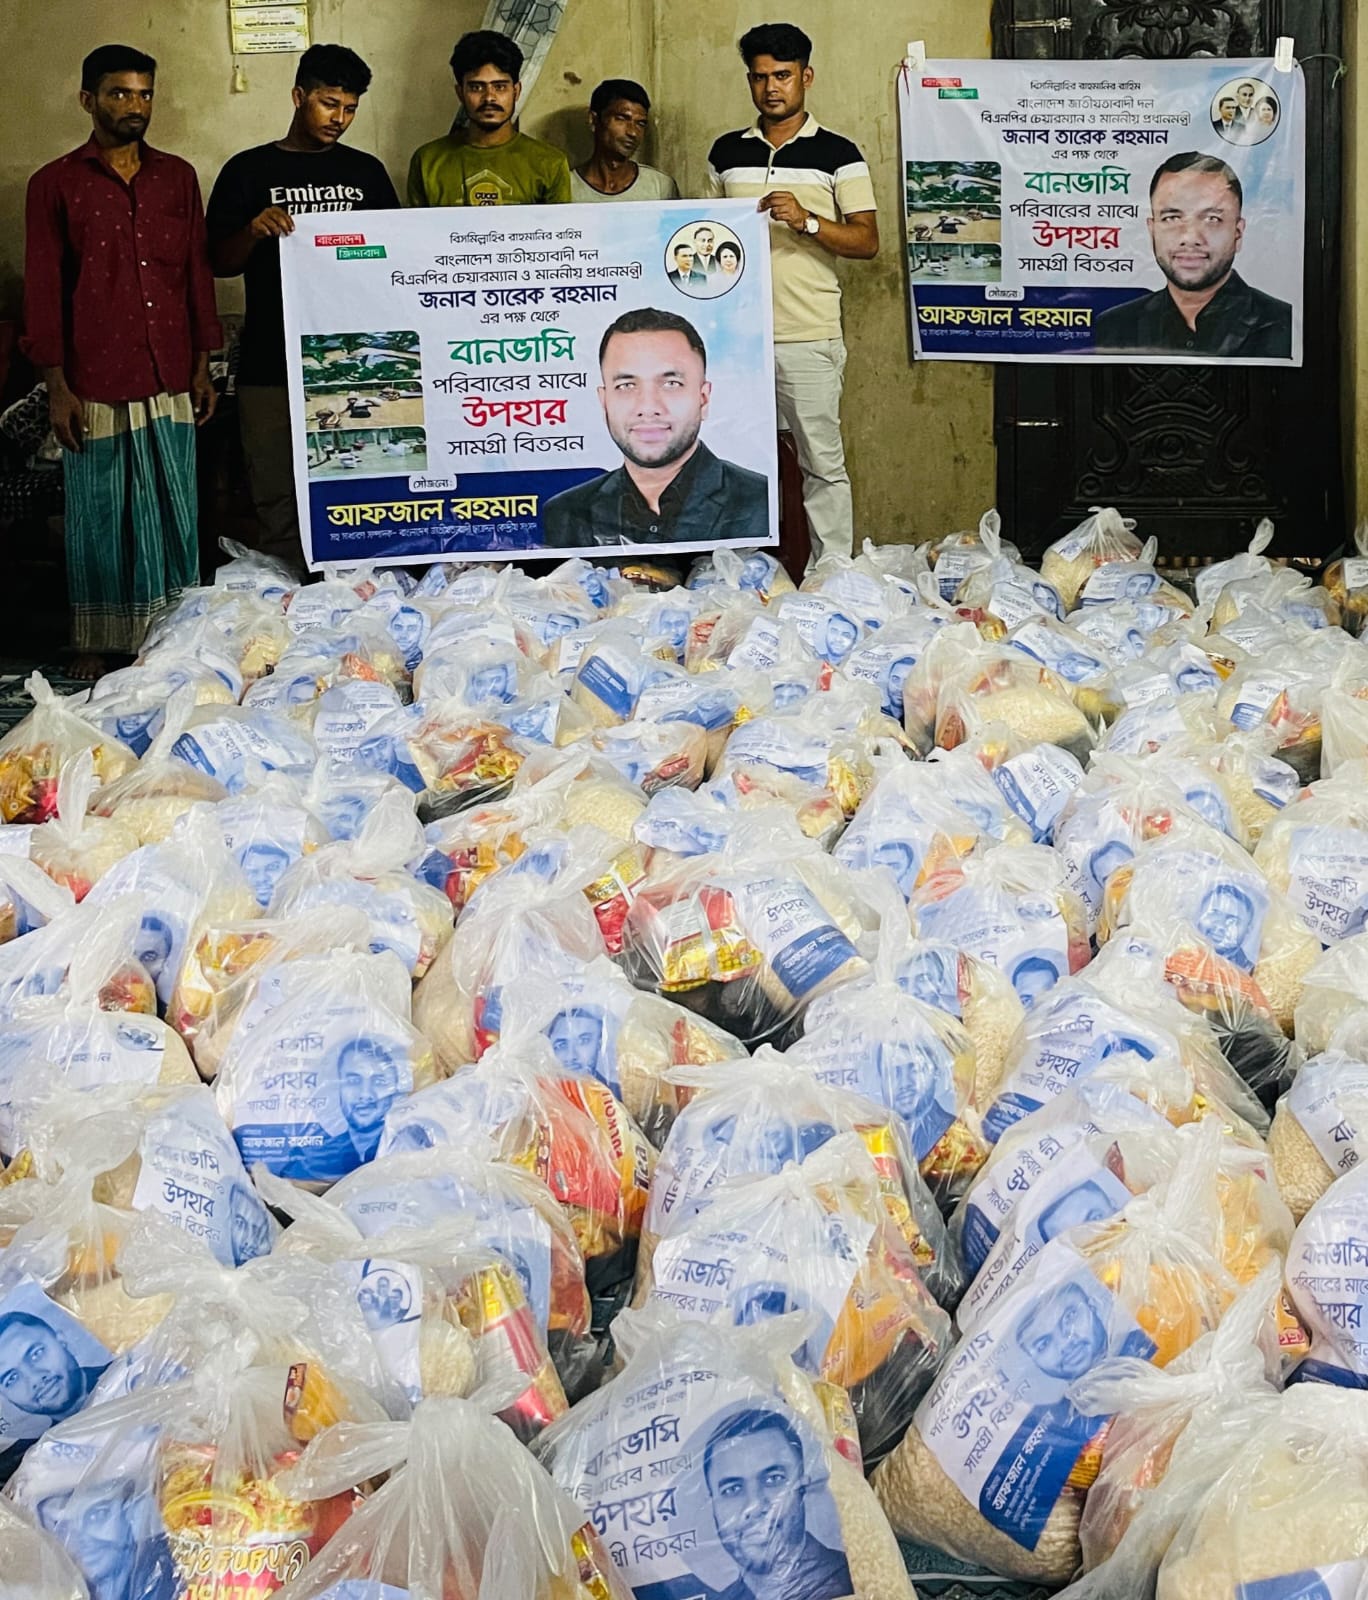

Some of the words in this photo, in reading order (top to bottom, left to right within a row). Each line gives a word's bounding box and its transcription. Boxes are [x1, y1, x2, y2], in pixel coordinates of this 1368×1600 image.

[1017, 98, 1064, 109] বাংলাদেশ
[1068, 95, 1134, 109] জাতীয়তাবাদী
[1137, 98, 1154, 109] দল
[981, 110, 1027, 123] বিএনপির
[1030, 112, 1085, 124] চেয়ারম্যান
[1088, 115, 1096, 123] ও
[1100, 110, 1140, 124] মাননীয়
[1143, 110, 1191, 127] প্রধানমন্ত্রী
[1002, 130, 1050, 145] জনাব
[1055, 130, 1106, 145] তারেক
[1112, 130, 1169, 146] রহমান
[1051, 150, 1067, 160] এর
[1072, 150, 1090, 160] পক্ষ
[1093, 150, 1119, 160] থেকে
[1024, 166, 1132, 195] বানভাসি
[270, 184, 364, 204] Emirates
[1009, 199, 1091, 218] পরিবারের
[1097, 204, 1138, 219] মাঝে
[317, 234, 362, 245] বাংলাদেশ
[450, 231, 505, 246] বিসমিল্লাহির
[508, 229, 553, 242] রাহমানির
[555, 228, 582, 240] রাহিম
[1032, 220, 1121, 249] উপহার
[434, 253, 492, 267] বাংলাদেশ
[496, 246, 575, 264] জাতীয়তাবাদী
[578, 249, 599, 262] দল
[1019, 253, 1067, 272] সামগ্রী
[1074, 254, 1134, 272] বিতরন
[391, 270, 448, 287] বিএনপির
[452, 270, 518, 285] চেয়ারম্যান
[521, 272, 531, 281] ও
[535, 264, 583, 280] মাননীয়
[586, 262, 643, 280] প্রধানমন্ত্রী
[418, 290, 476, 310] জনাব
[482, 287, 545, 307] তারেক
[551, 284, 618, 304] রহমান
[480, 313, 500, 325] এর
[504, 311, 526, 324] পক্ষ
[530, 309, 560, 322] থেকে
[918, 306, 1013, 326] আফজাল
[1019, 309, 1092, 328] রহমান
[448, 328, 576, 366] বানভাসি
[432, 372, 531, 394] পরিবারের
[537, 373, 588, 389] মাঝে
[462, 396, 568, 427] উপহার
[447, 433, 506, 456] সামগ্রী
[513, 432, 584, 453] বিতরন
[326, 499, 445, 526] আফজাল
[450, 495, 538, 521] রহমান
[1304, 891, 1352, 924] উপহার
[1035, 1050, 1083, 1078] উপহার
[815, 1069, 859, 1086] পহার
[633, 1145, 649, 1191] Tea
[162, 1177, 215, 1217] উপহার
[700, 1298, 723, 1313] মা
[1318, 1303, 1364, 1330] পহার
[952, 1369, 1011, 1439] উপহার
[584, 1414, 681, 1477] বানভাসি
[964, 1426, 995, 1474] সামগ্রী
[992, 1453, 1027, 1511] আফজাল
[584, 1486, 679, 1536] উপহার
[633, 1530, 697, 1564] বিতরন
